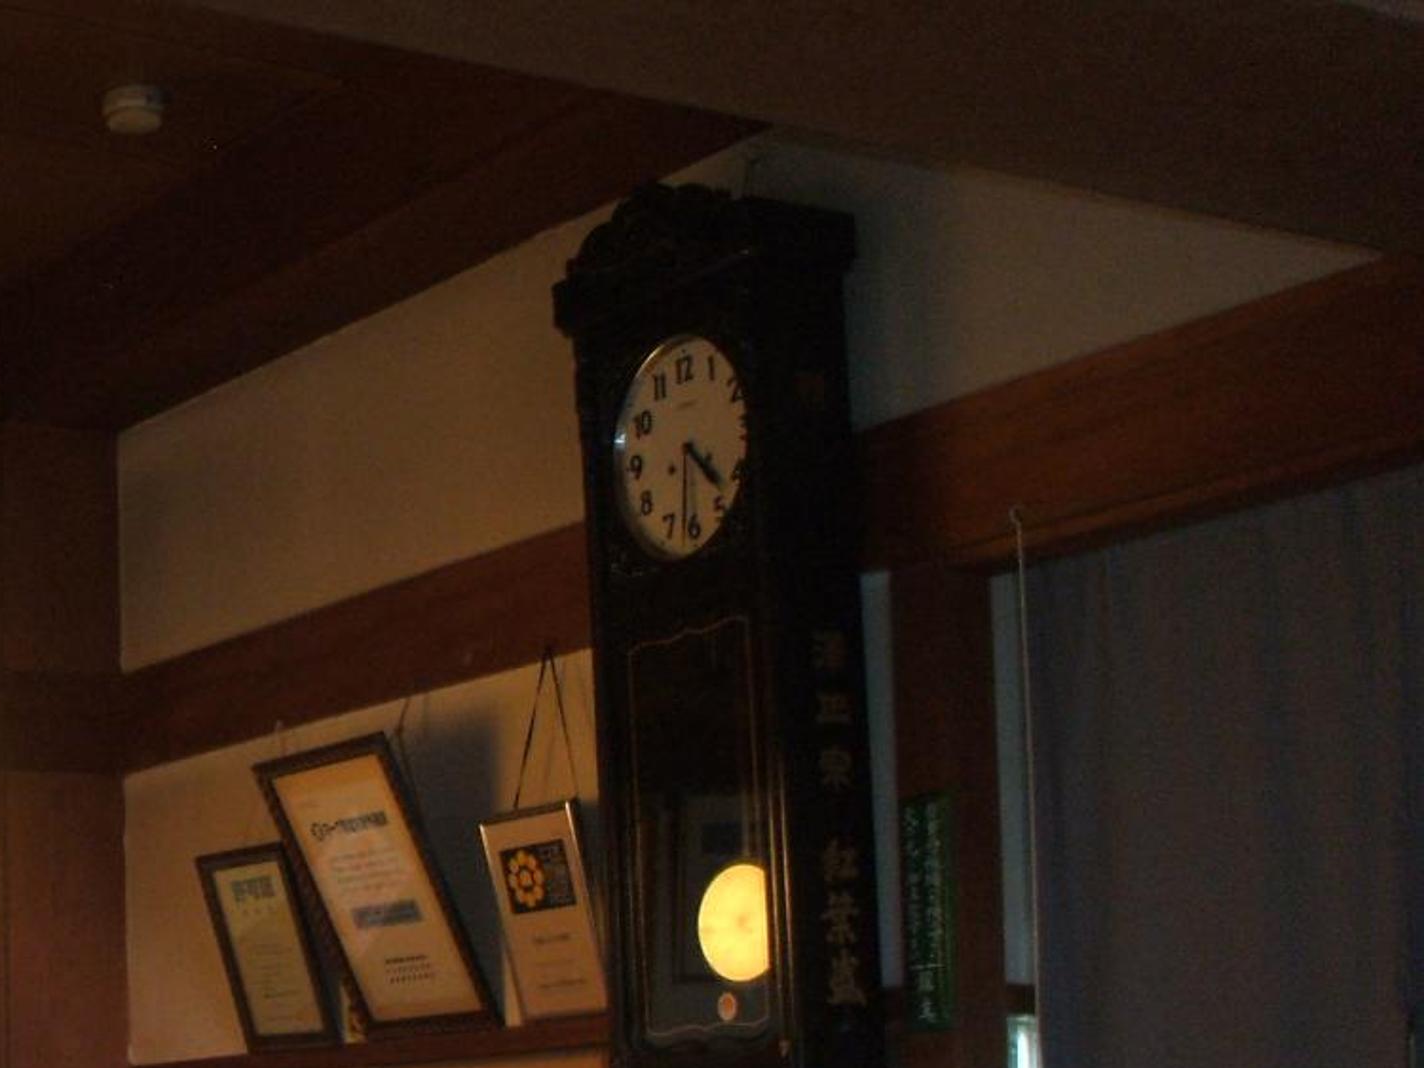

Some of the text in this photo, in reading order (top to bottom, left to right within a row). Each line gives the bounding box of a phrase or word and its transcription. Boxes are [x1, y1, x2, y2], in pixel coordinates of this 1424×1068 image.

[675, 356, 693, 385] 12
[707, 355, 715, 381] 1
[652, 373, 667, 401] 11
[628, 455, 643, 480] 9
[640, 490, 653, 516] 8
[662, 513, 676, 539] 7
[687, 515, 702, 540] 6
